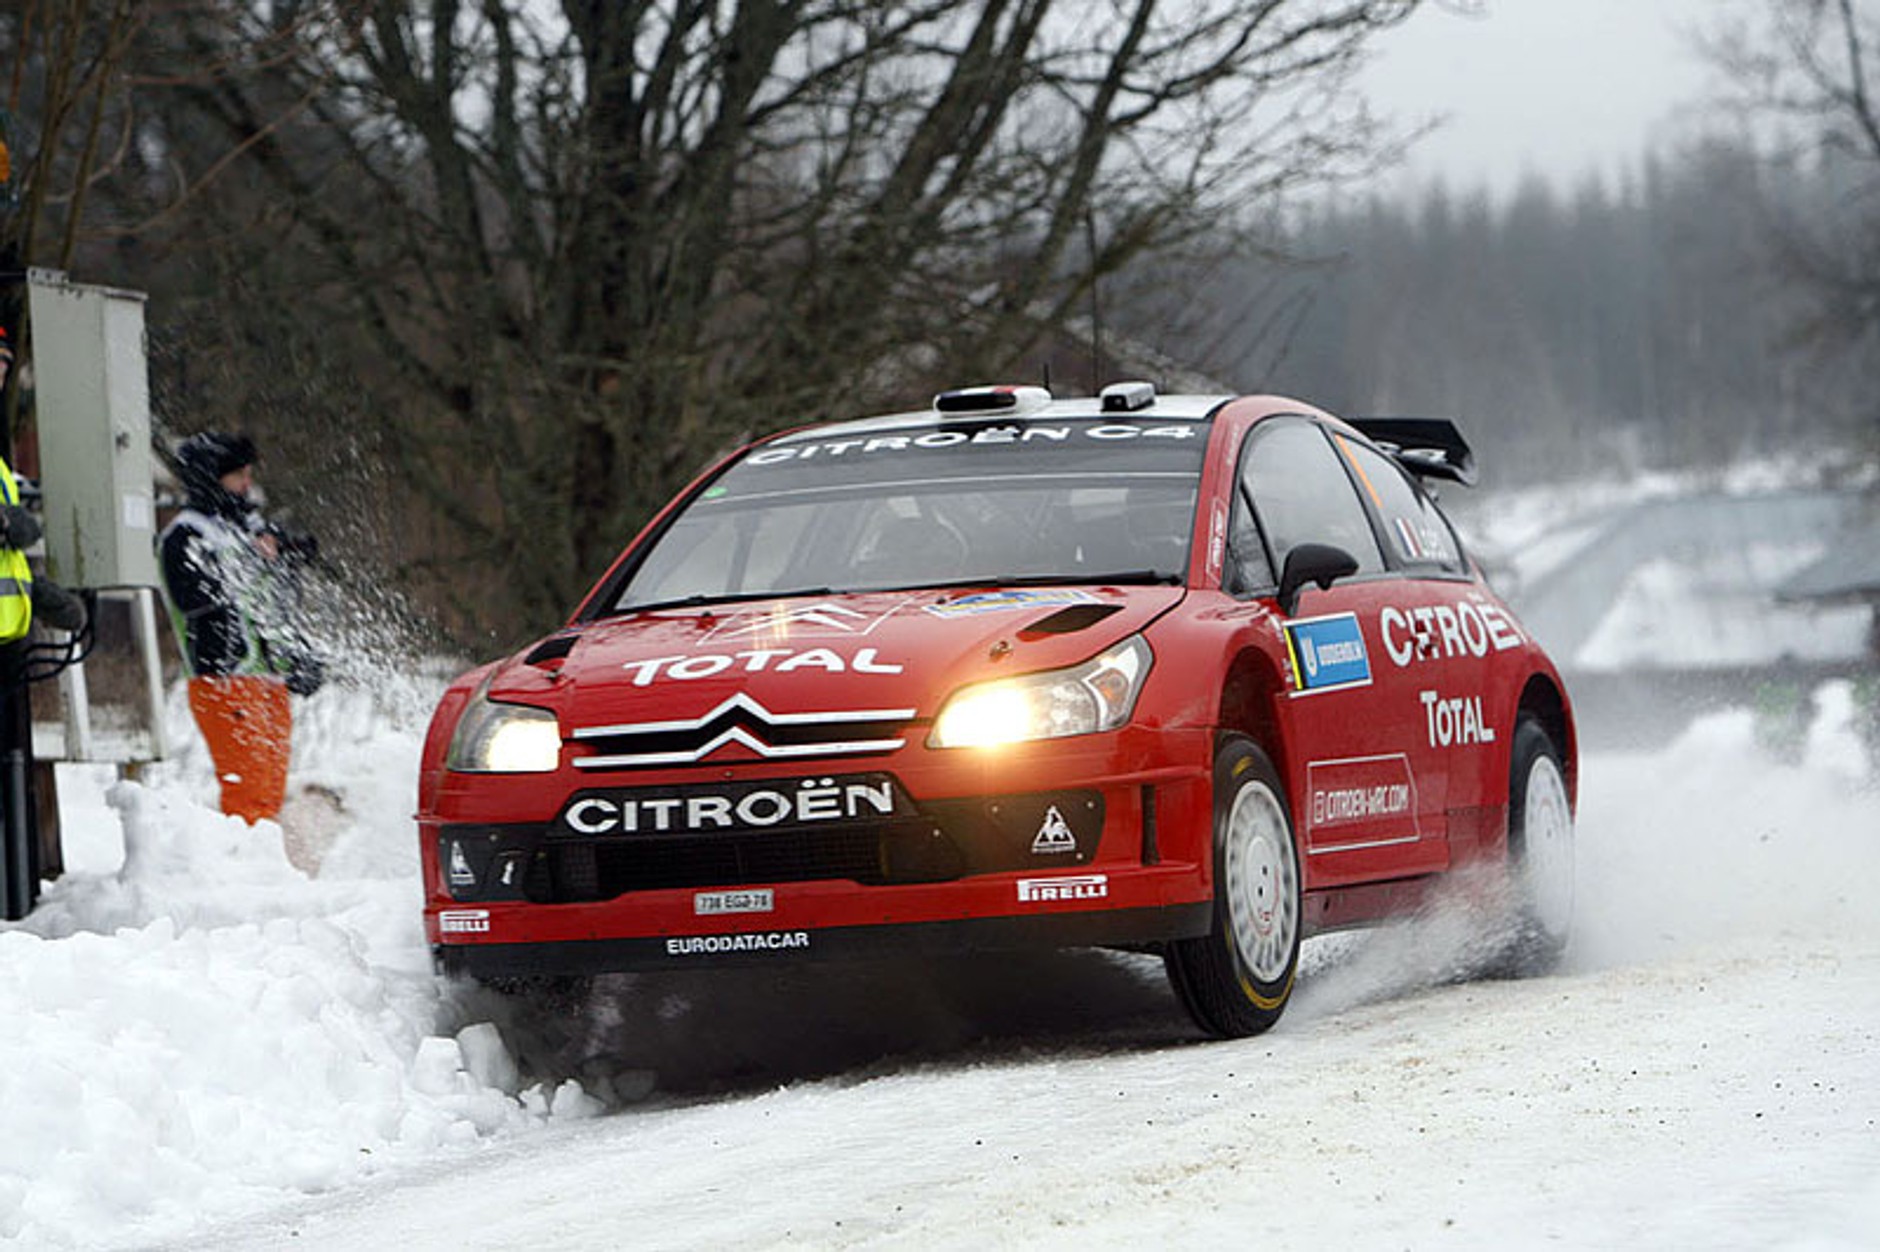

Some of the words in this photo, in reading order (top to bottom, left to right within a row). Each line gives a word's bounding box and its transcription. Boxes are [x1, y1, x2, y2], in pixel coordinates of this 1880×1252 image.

[746, 426, 1071, 465] CITROËN
[1085, 424, 1196, 440] C4
[623, 648, 904, 687] TOTAL
[1419, 690, 1496, 748] TOTAL
[565, 777, 894, 834] CITROËN
[1015, 874, 1108, 902] PIRELLI
[666, 931, 809, 954] EURODATACAR
